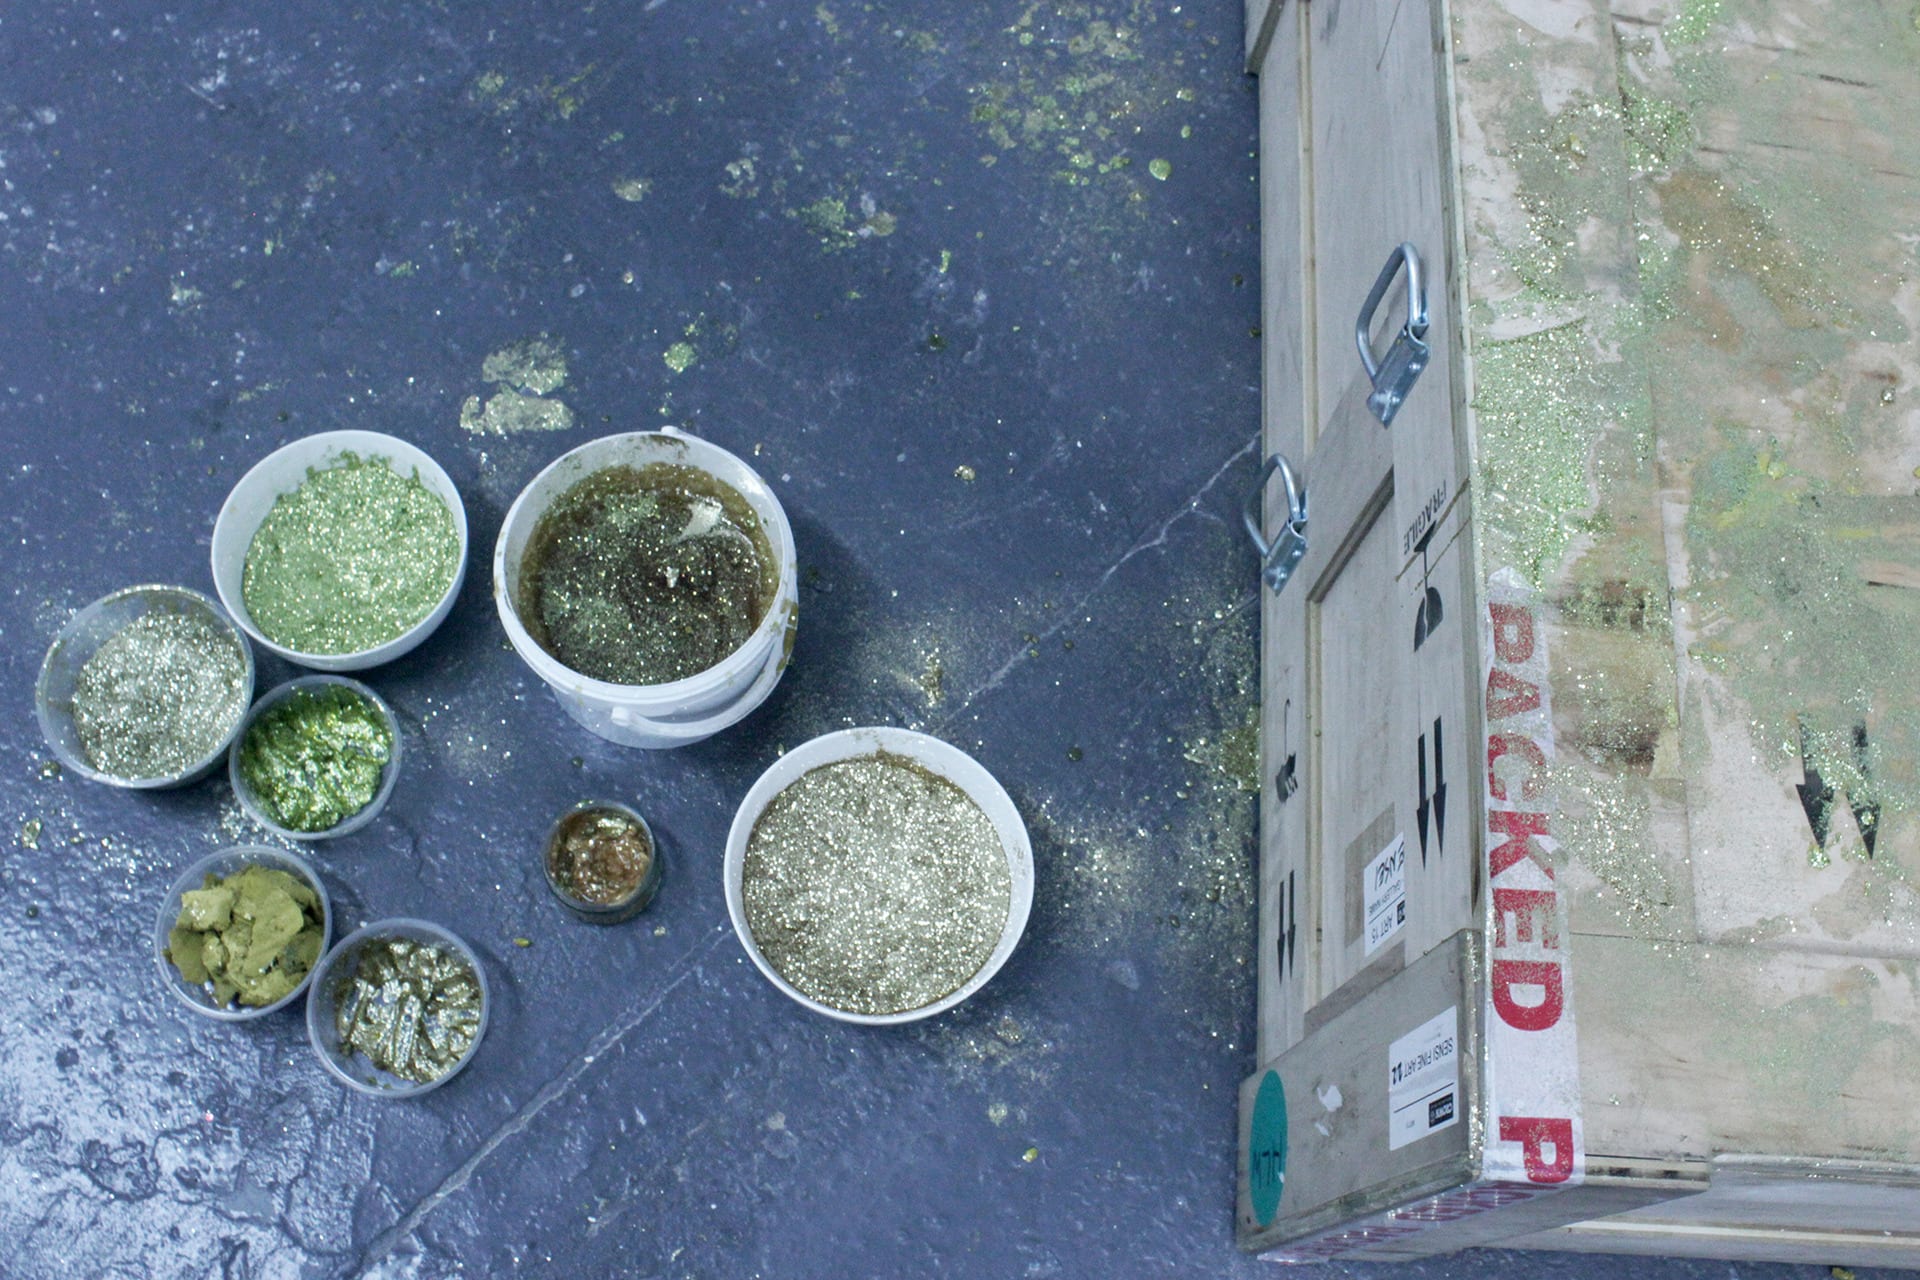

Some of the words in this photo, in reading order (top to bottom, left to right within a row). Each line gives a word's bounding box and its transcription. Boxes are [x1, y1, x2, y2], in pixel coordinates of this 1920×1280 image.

[1404, 480, 1446, 555] FRAGILE
[1487, 602, 1564, 1031] PACKED
[1380, 912, 1394, 938] ART
[1417, 1050, 1432, 1070] FINE
[1432, 1037, 1454, 1061] SENSI
[1404, 1058, 1417, 1078] ART
